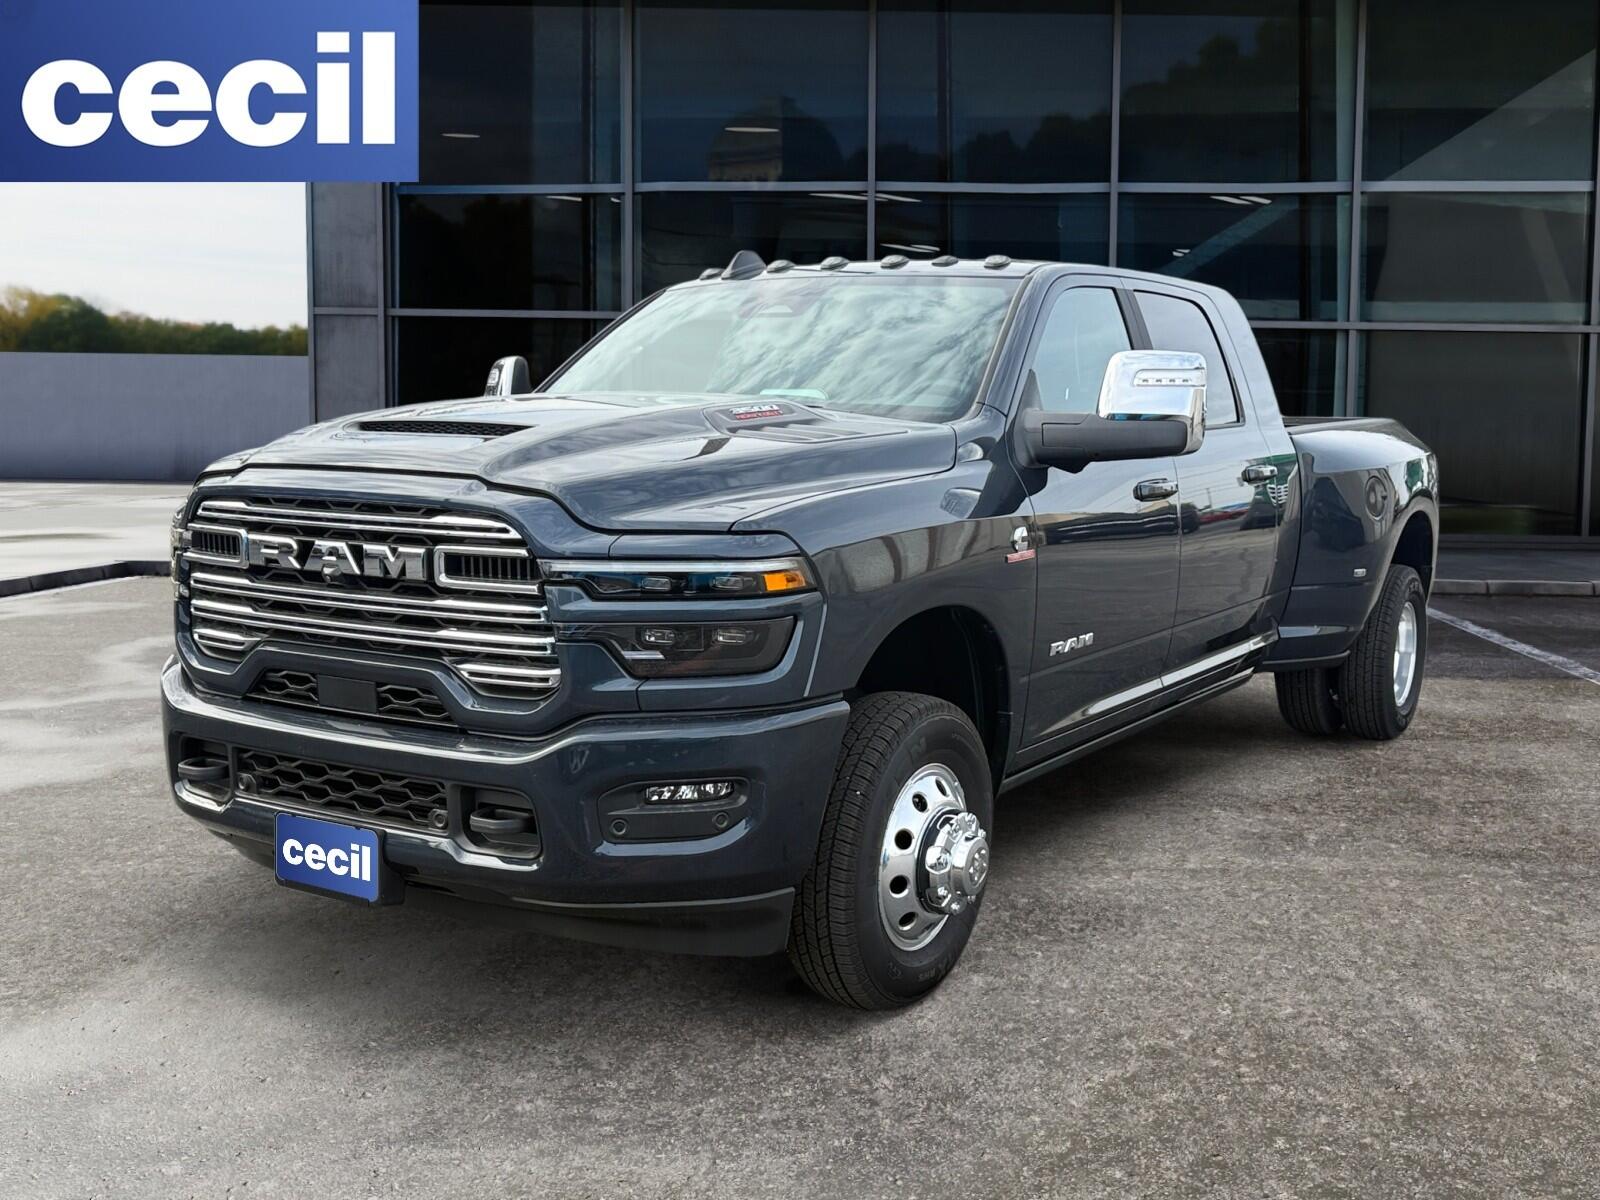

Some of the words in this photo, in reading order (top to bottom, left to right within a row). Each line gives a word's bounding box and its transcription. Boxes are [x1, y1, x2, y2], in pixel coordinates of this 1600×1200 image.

[248, 533, 427, 581] RAM
[1049, 632, 1094, 657] RAM
[282, 838, 371, 882] cecil
